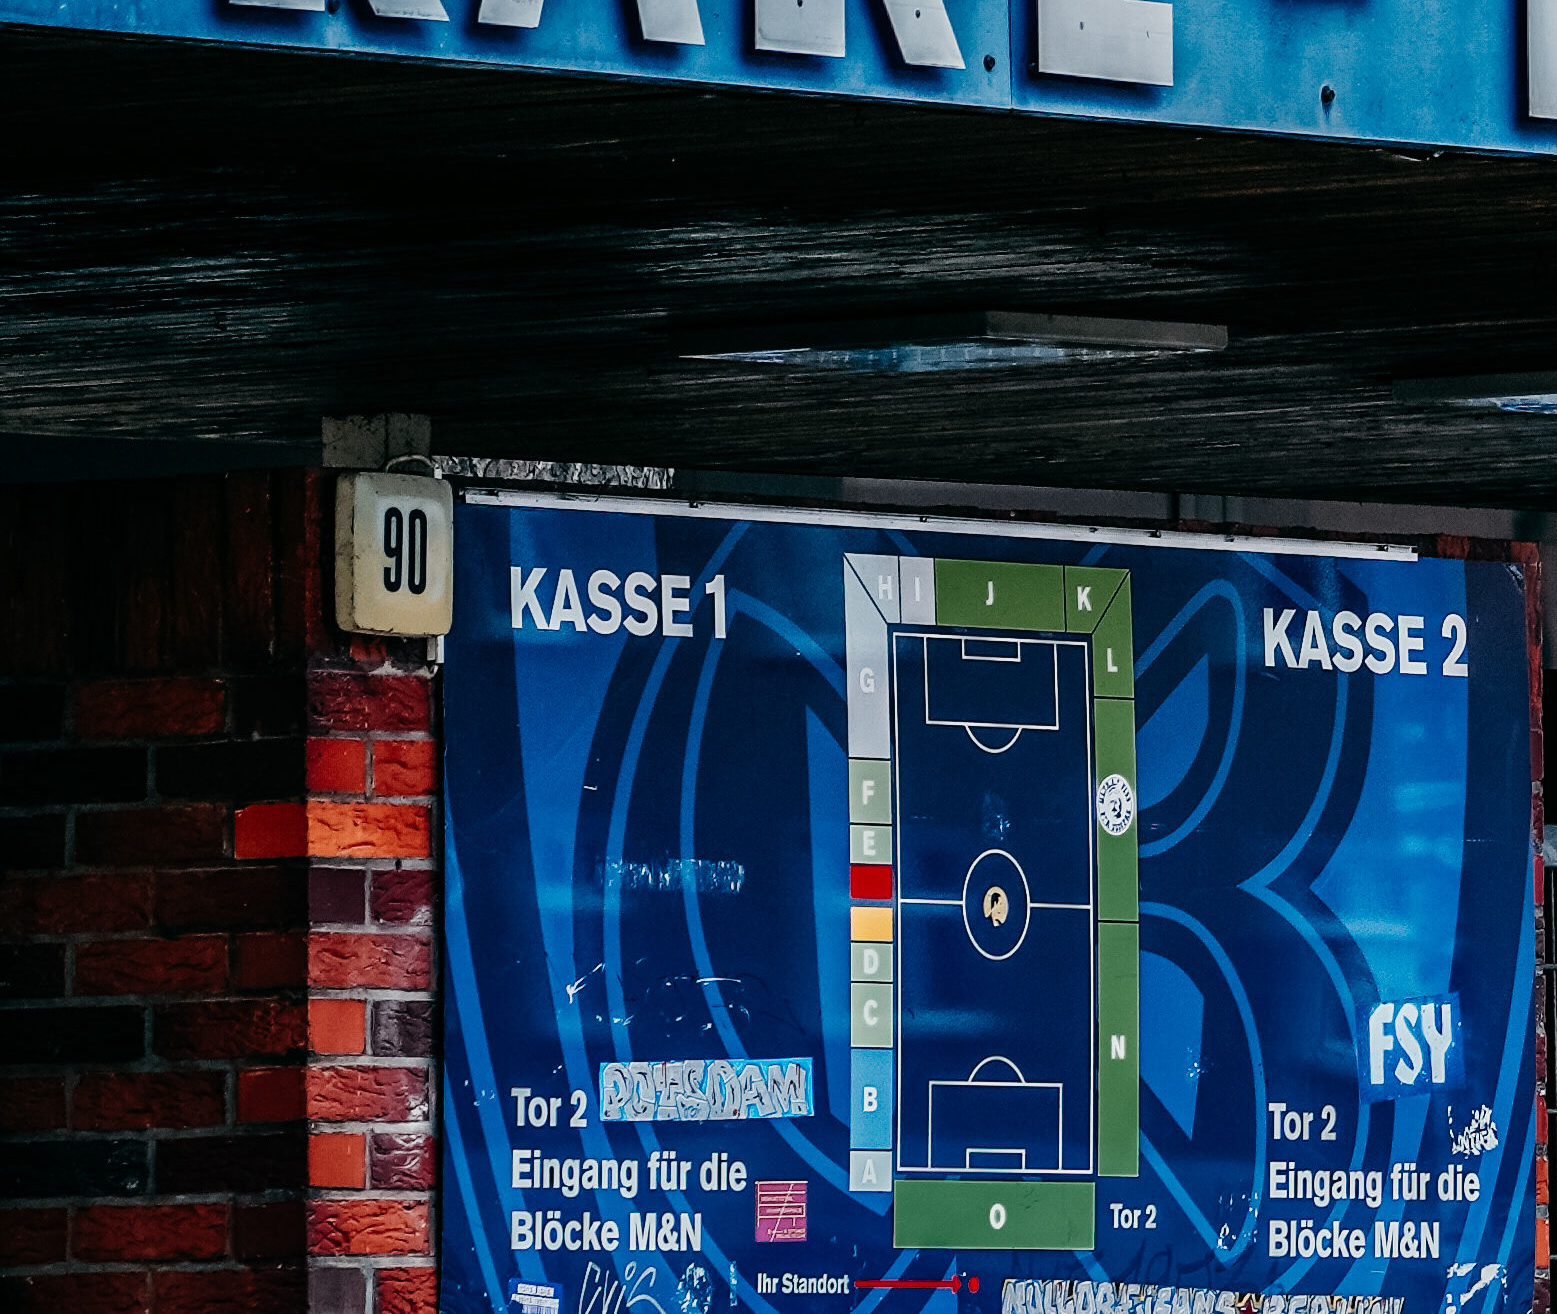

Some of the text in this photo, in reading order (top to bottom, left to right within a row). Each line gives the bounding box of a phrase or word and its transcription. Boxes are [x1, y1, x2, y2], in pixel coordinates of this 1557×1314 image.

[382, 504, 431, 596] 90
[878, 575, 893, 600] H
[985, 581, 994, 605] J
[1077, 586, 1091, 611] K
[510, 566, 727, 639] KASSE 1
[1263, 607, 1469, 677] KASSE 2
[1106, 648, 1118, 673] L
[859, 668, 875, 693] G
[862, 780, 875, 805] F
[863, 831, 876, 856] E
[864, 949, 879, 975] D
[862, 999, 879, 1026] C
[1110, 1035, 1126, 1060] N
[1369, 1002, 1454, 1085] FSY
[510, 1087, 588, 1128] Tor 2
[863, 1086, 879, 1113] B
[1268, 1102, 1337, 1141] Tor 2
[511, 1149, 747, 1199] Eingang für die
[861, 1158, 878, 1185] A
[1269, 1161, 1481, 1208] Eingang für die
[1109, 1203, 1157, 1229] Tor 2
[511, 1210, 702, 1252] Blöcke M&N
[1268, 1219, 1440, 1259] Blöcke M&N
[757, 1272, 850, 1294] Ihr Standort
